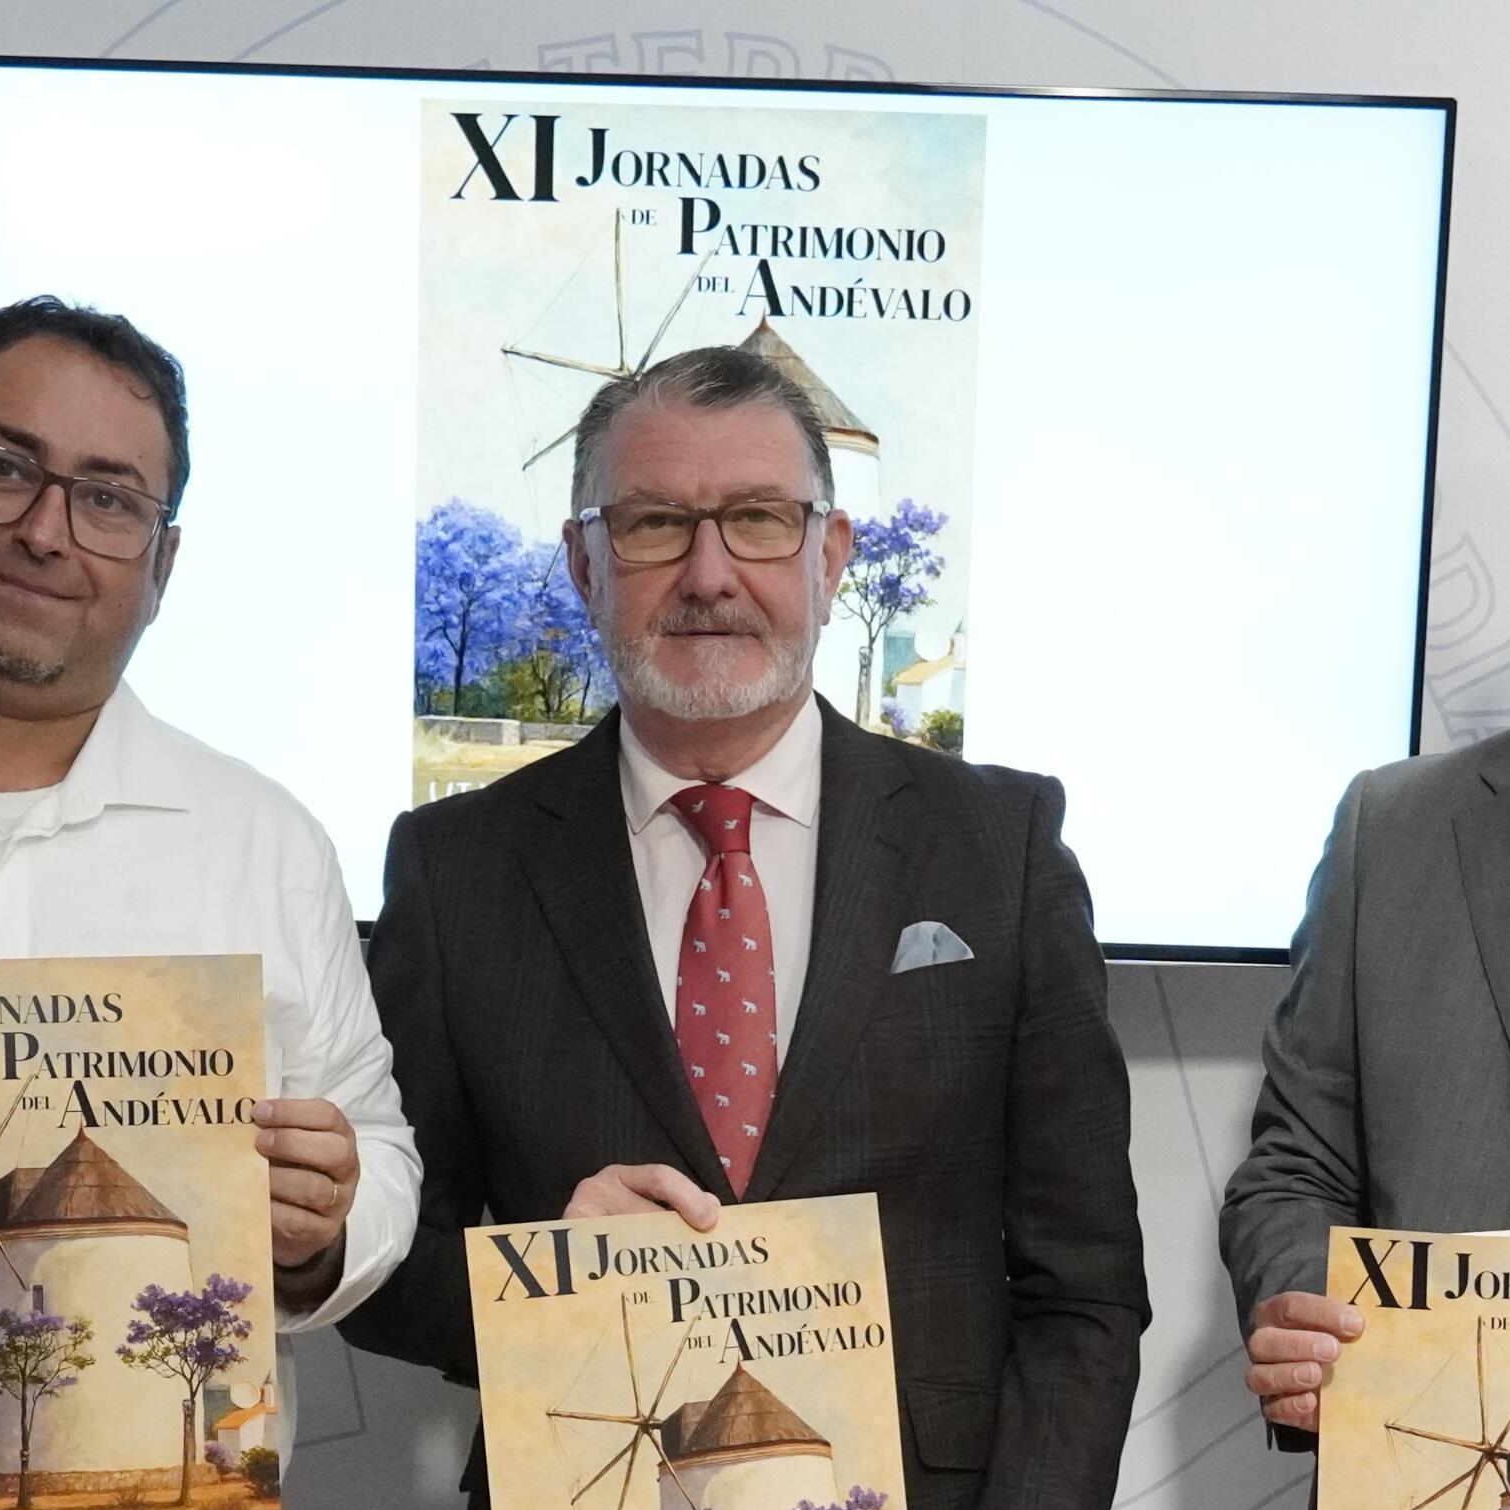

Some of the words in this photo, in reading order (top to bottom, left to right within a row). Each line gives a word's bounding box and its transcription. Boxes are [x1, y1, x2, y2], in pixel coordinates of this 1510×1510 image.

[450, 112, 561, 202] XI
[630, 209, 657, 225] DE
[697, 276, 734, 293] DEL
[22, 1095, 55, 1111] DEL
[487, 1228, 578, 1302] XI
[1349, 1236, 1433, 1311] XI
[633, 1291, 653, 1305] DE
[688, 1335, 715, 1350] DEL
